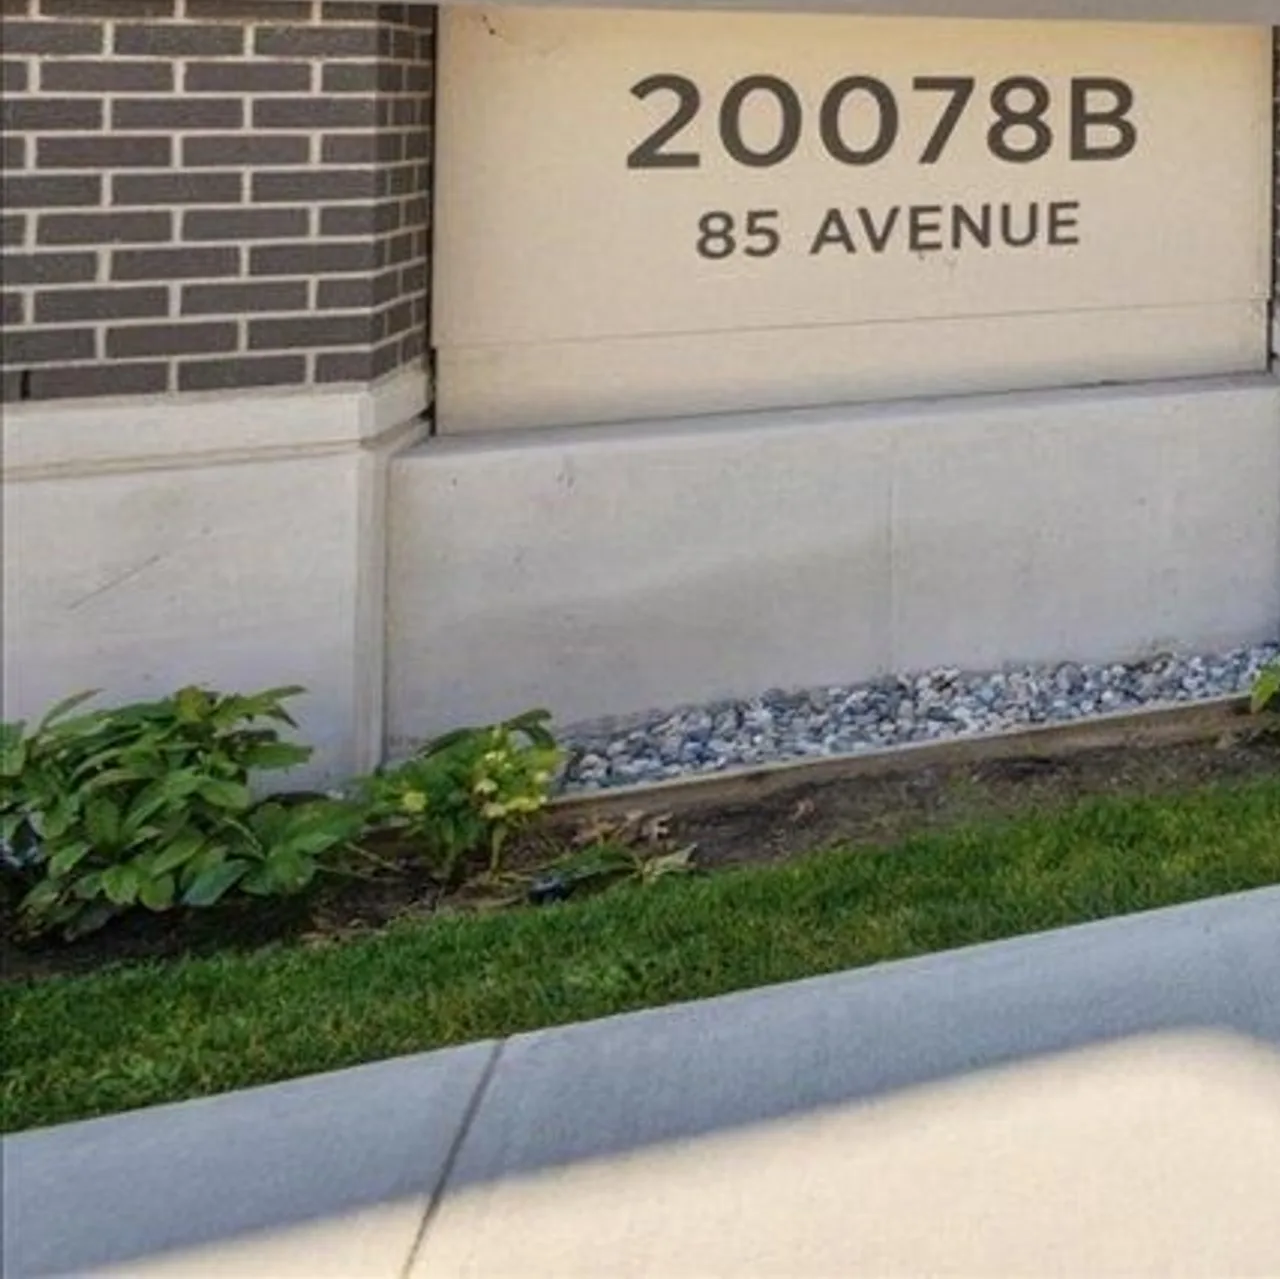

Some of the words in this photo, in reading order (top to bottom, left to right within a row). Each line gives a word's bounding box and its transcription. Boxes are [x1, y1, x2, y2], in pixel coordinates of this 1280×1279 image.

[624, 72, 1139, 170] 20078B
[695, 208, 781, 261] 85
[808, 200, 1081, 256] AVENUE
